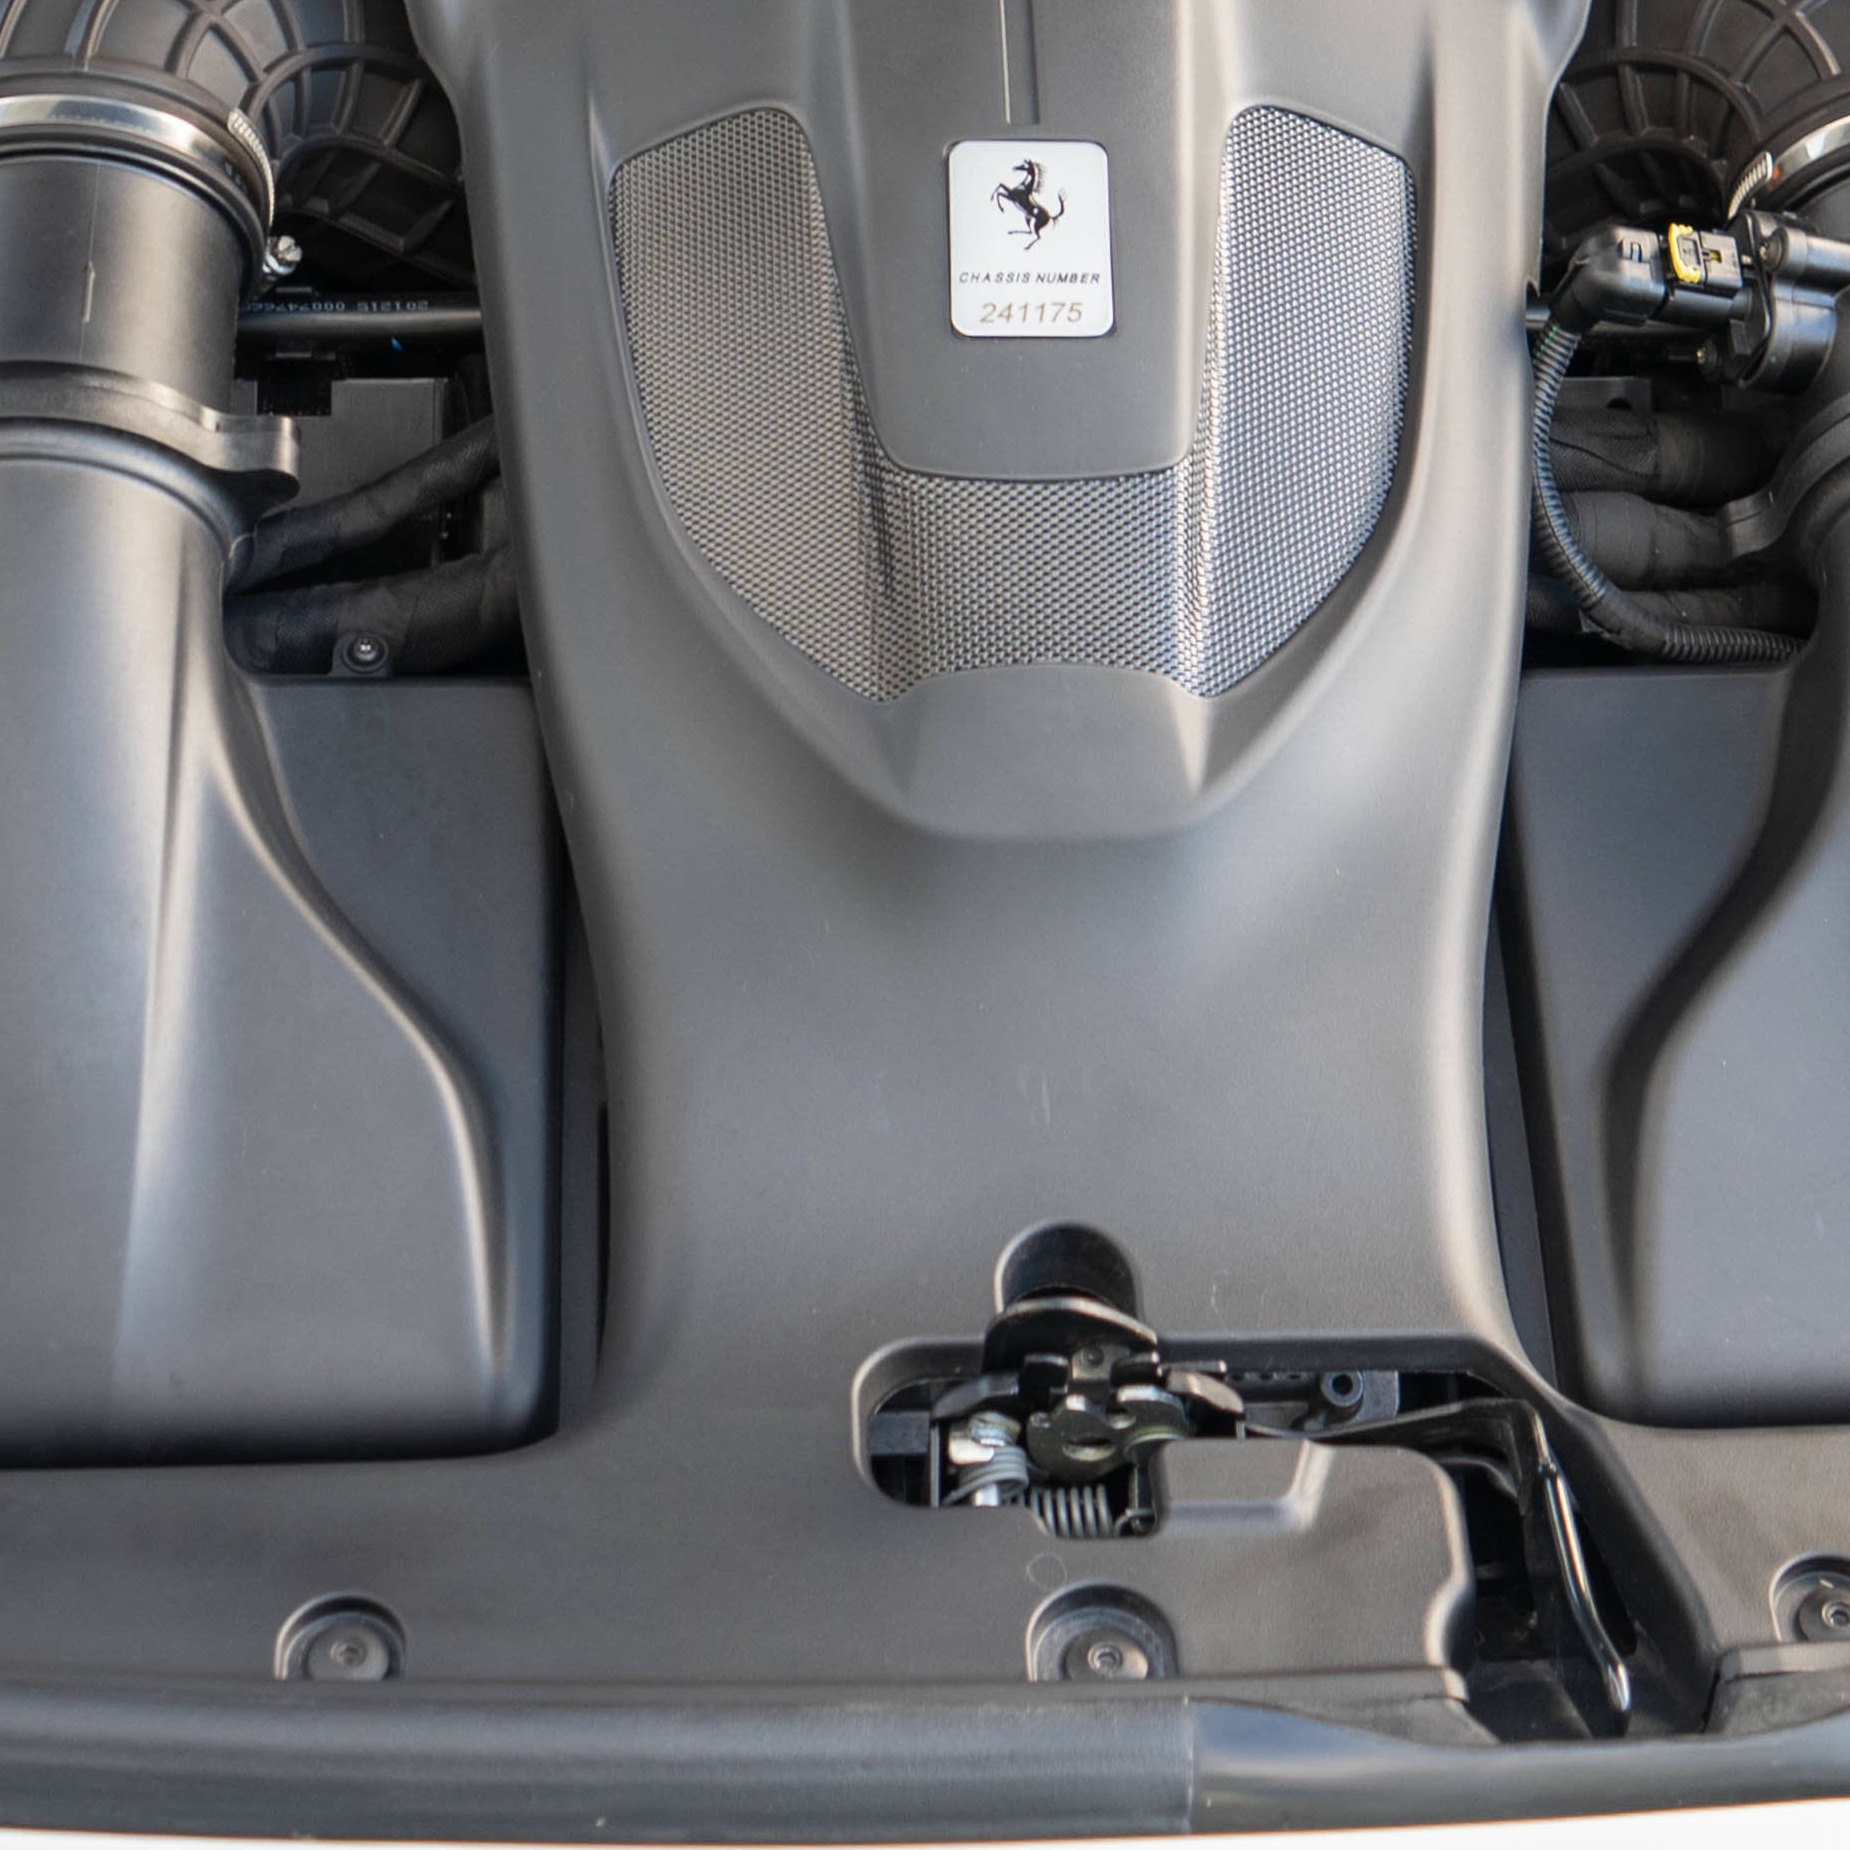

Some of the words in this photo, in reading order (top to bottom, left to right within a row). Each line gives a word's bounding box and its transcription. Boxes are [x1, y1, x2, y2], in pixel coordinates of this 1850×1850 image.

[959, 271, 1030, 284] CHASSIS
[1035, 271, 1101, 284] NUMBER
[979, 302, 1084, 324] 241175
